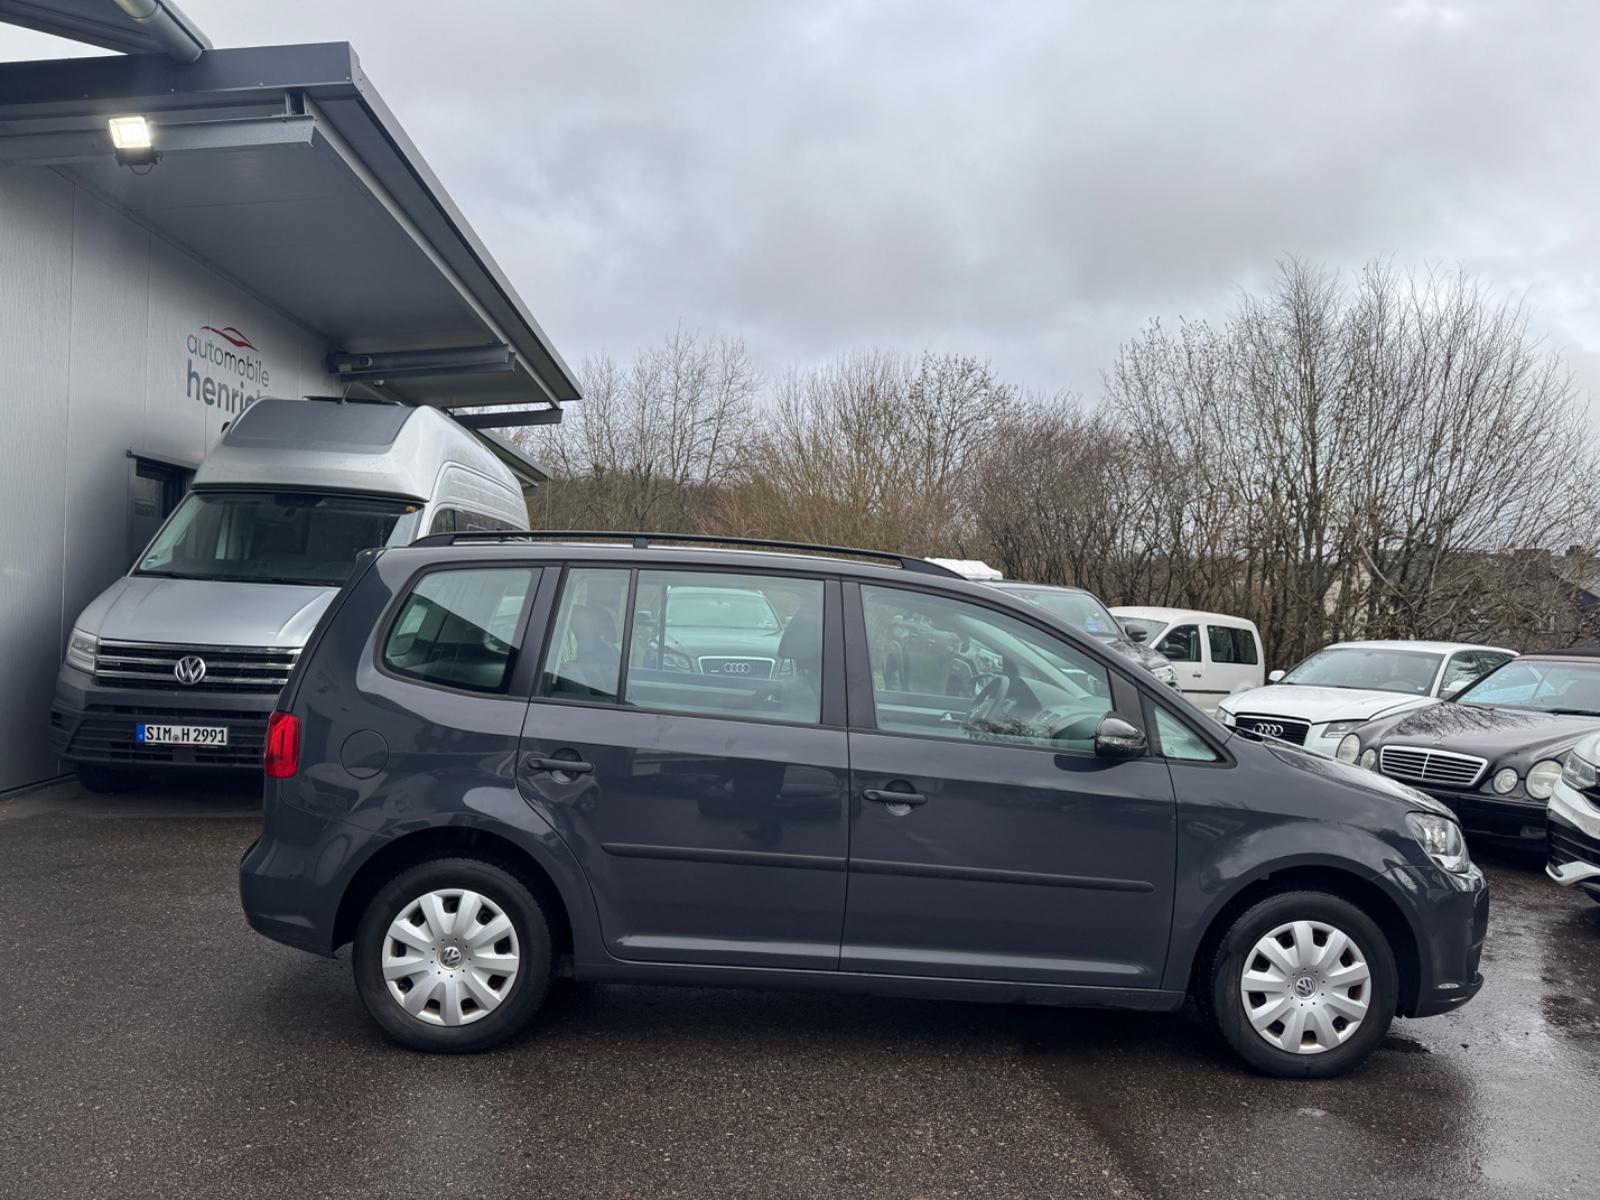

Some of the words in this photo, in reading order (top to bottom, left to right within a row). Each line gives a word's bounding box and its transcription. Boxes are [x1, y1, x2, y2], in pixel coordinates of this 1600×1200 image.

[187, 334, 269, 387] automobile
[187, 359, 261, 414] henri
[146, 726, 172, 742] SIM
[181, 727, 190, 742] H
[193, 728, 226, 743] 2991
